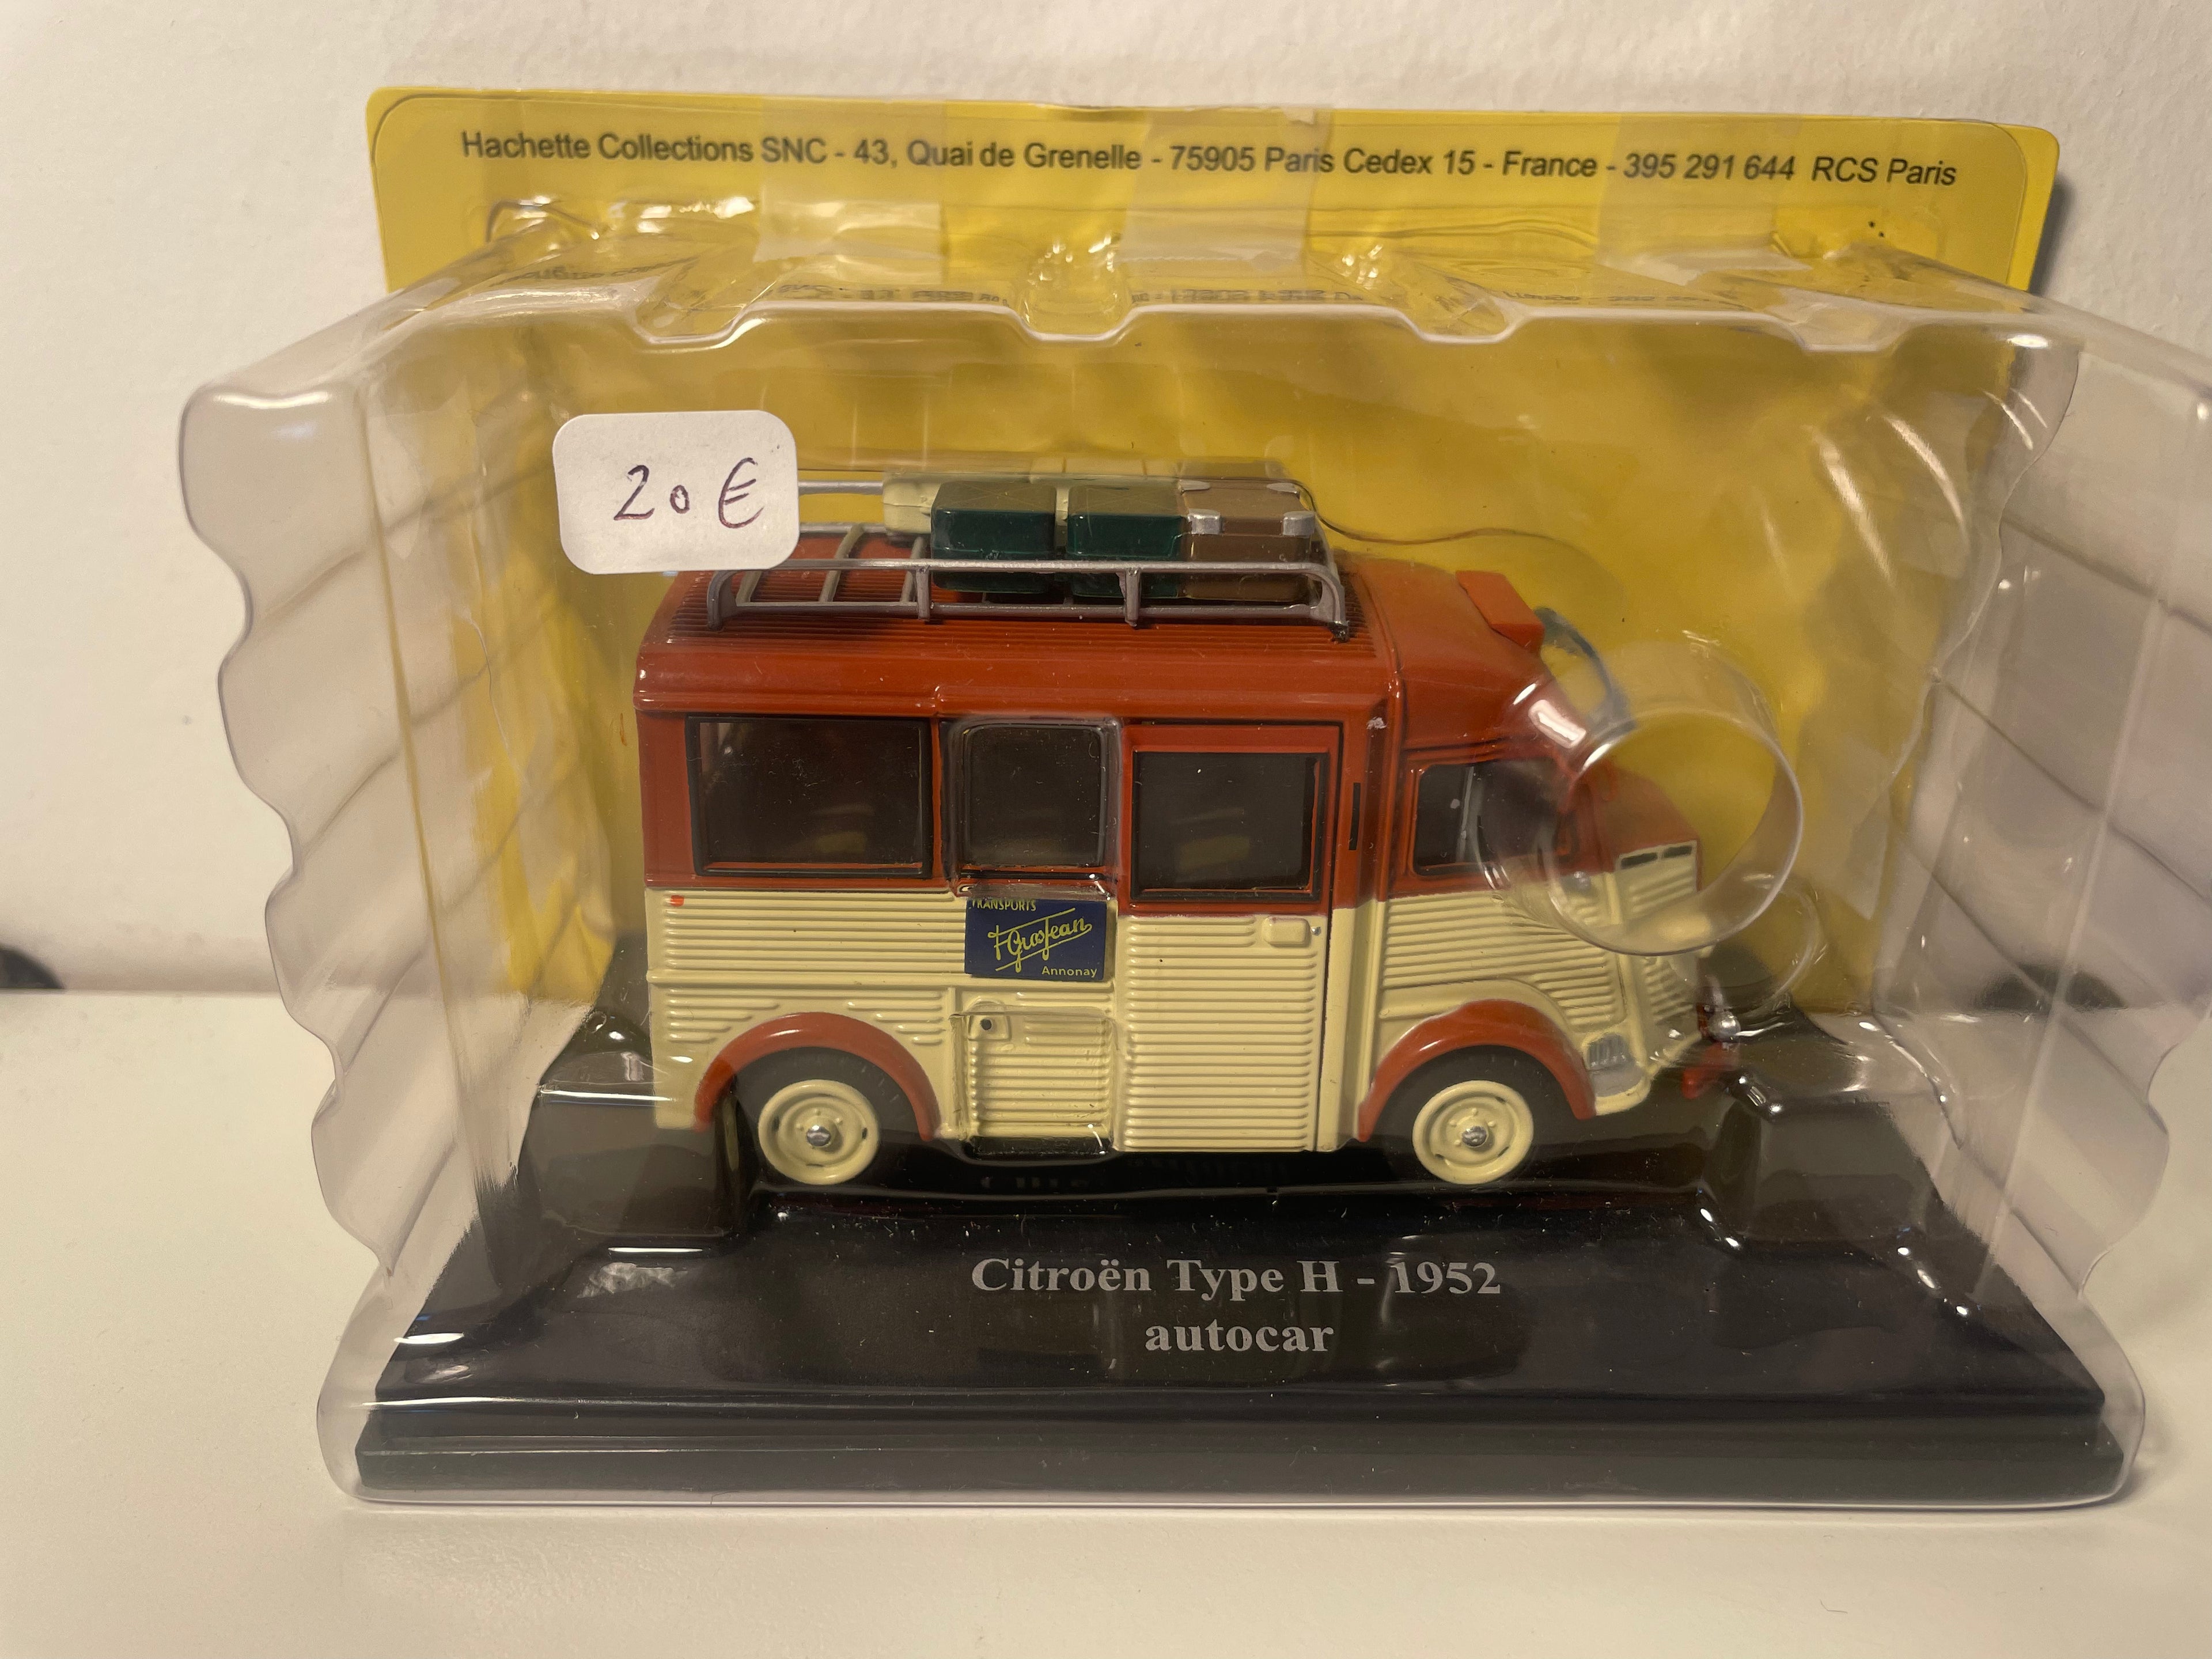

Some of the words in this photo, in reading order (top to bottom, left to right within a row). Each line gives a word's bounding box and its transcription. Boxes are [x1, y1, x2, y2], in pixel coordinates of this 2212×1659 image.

[462, 131, 590, 160] Hachette
[597, 133, 754, 162] Collections
[761, 136, 827, 164] SNC
[853, 138, 897, 168] 43,
[906, 139, 973, 167] Quai
[980, 141, 1016, 168] de
[1023, 142, 1142, 170] Grenelle
[1169, 145, 1256, 172] 75905
[1264, 146, 1335, 173] Paris
[1343, 147, 1433, 175] Cedex
[1444, 149, 1476, 176] 15
[1502, 150, 1599, 177] France
[1624, 153, 1676, 179] 395
[1684, 154, 1735, 180] 291
[1744, 154, 1796, 181] 644
[1811, 156, 1879, 183] RCS
[1887, 158, 1957, 186] Paris
[614, 465, 690, 521] 20
[718, 457, 764, 529] €
[1041, 965, 1097, 978] Annonay
[972, 1258, 1152, 1291] Citroën
[1167, 1260, 1284, 1301] Type
[1297, 1260, 1343, 1293] H
[1390, 1261, 1501, 1294] 1952
[1145, 1319, 1334, 1352] autocar
